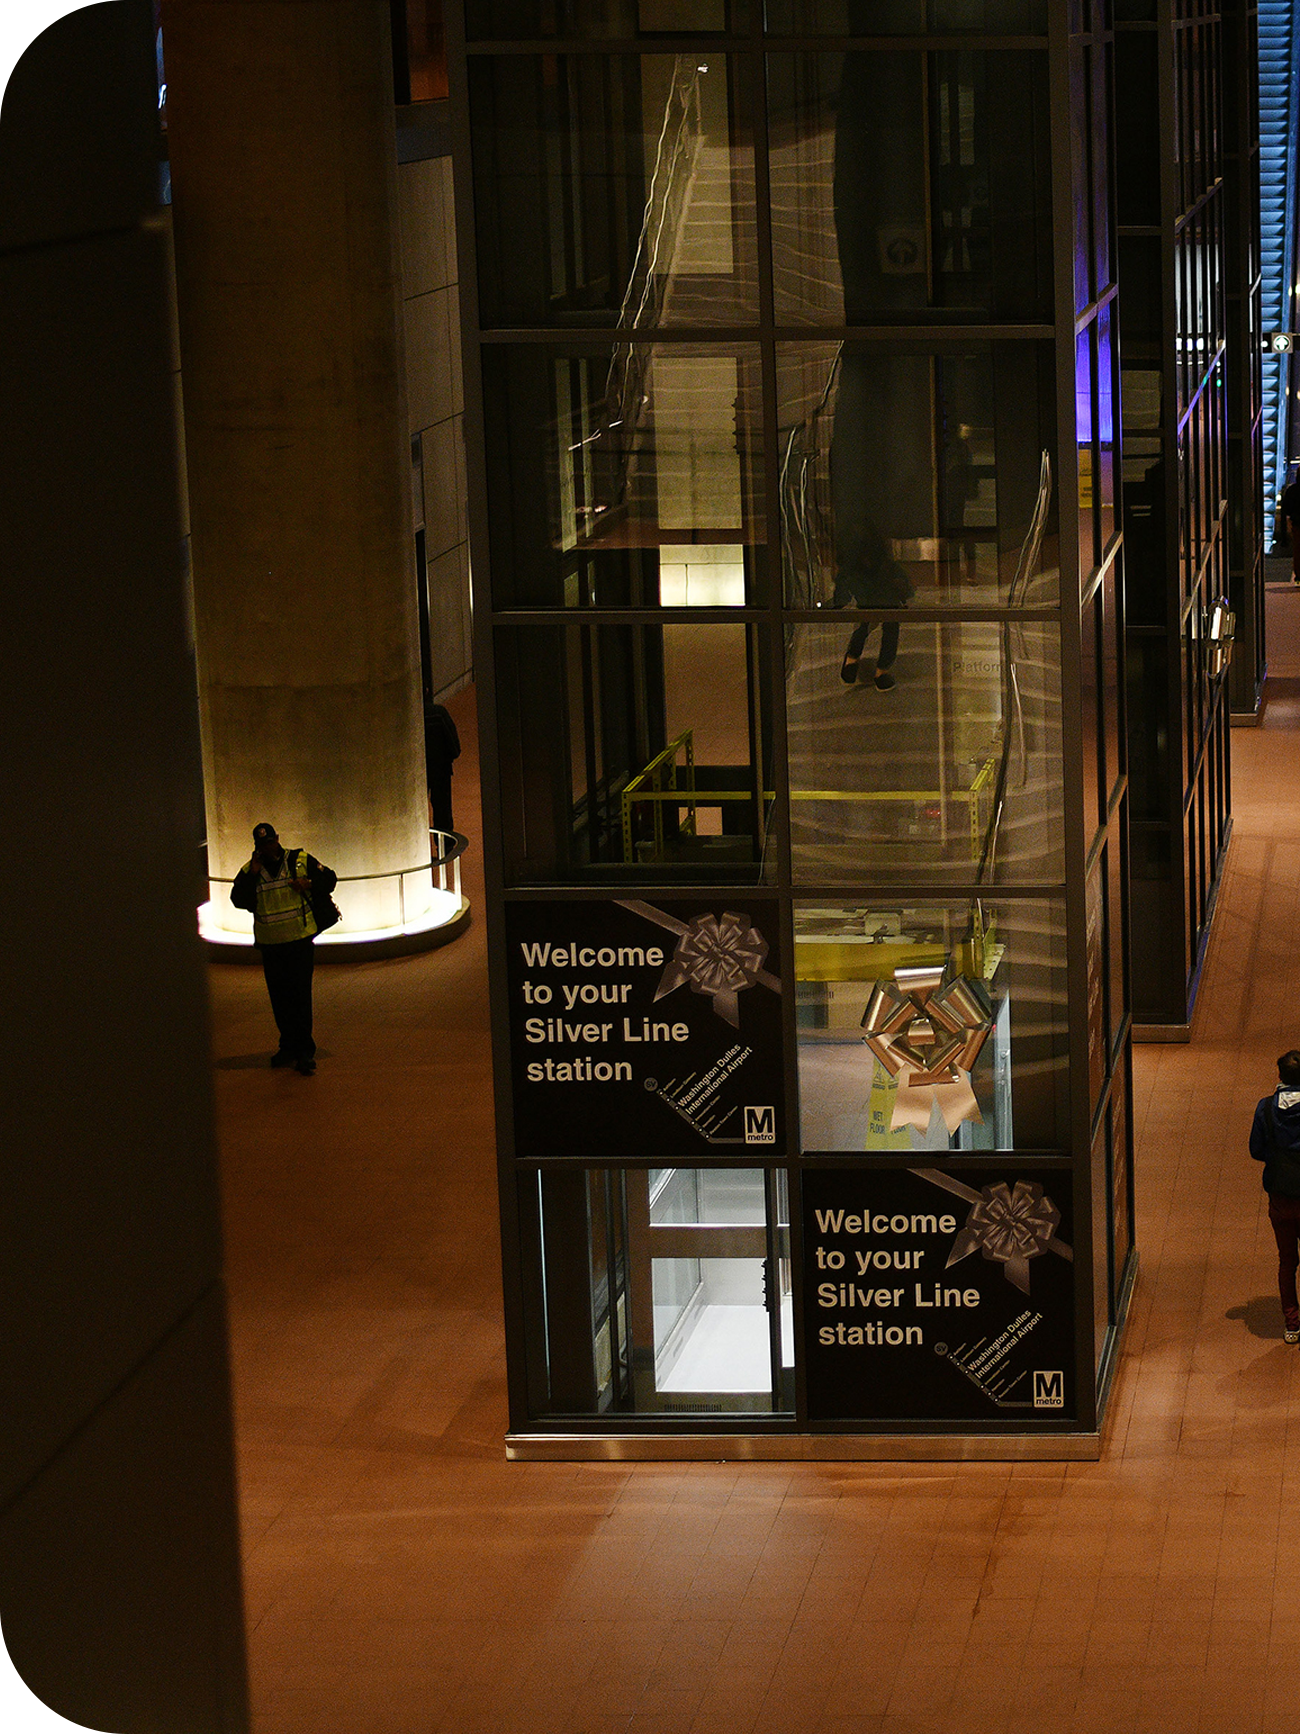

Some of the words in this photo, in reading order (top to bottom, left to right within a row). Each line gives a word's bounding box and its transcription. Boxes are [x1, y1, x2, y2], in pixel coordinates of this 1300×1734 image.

[521, 943, 664, 967] Welcome
[523, 981, 553, 1004] to
[562, 984, 632, 1010] your
[525, 1018, 612, 1043] Silver
[624, 1017, 689, 1042] Line
[527, 1056, 633, 1081] station
[677, 1066, 720, 1107] Washington
[716, 1043, 742, 1068] Dulles
[685, 1072, 729, 1115] International
[728, 1046, 754, 1073] Airport
[747, 1109, 773, 1133] M
[873, 1110, 884, 1122] WET
[747, 1133, 774, 1141] metro
[869, 1122, 886, 1135] FLOOR
[815, 1209, 957, 1233] Welcome
[816, 1247, 846, 1270] to
[855, 1250, 925, 1276] your
[817, 1283, 905, 1308] Silver
[916, 1283, 980, 1307] Line
[818, 1321, 923, 1345] station
[967, 1331, 1010, 1372] Washington
[1006, 1309, 1032, 1334] Dulles
[974, 1336, 1019, 1379] International
[1018, 1312, 1044, 1339] Airport
[1036, 1374, 1061, 1397] M
[1036, 1397, 1062, 1406] metro
